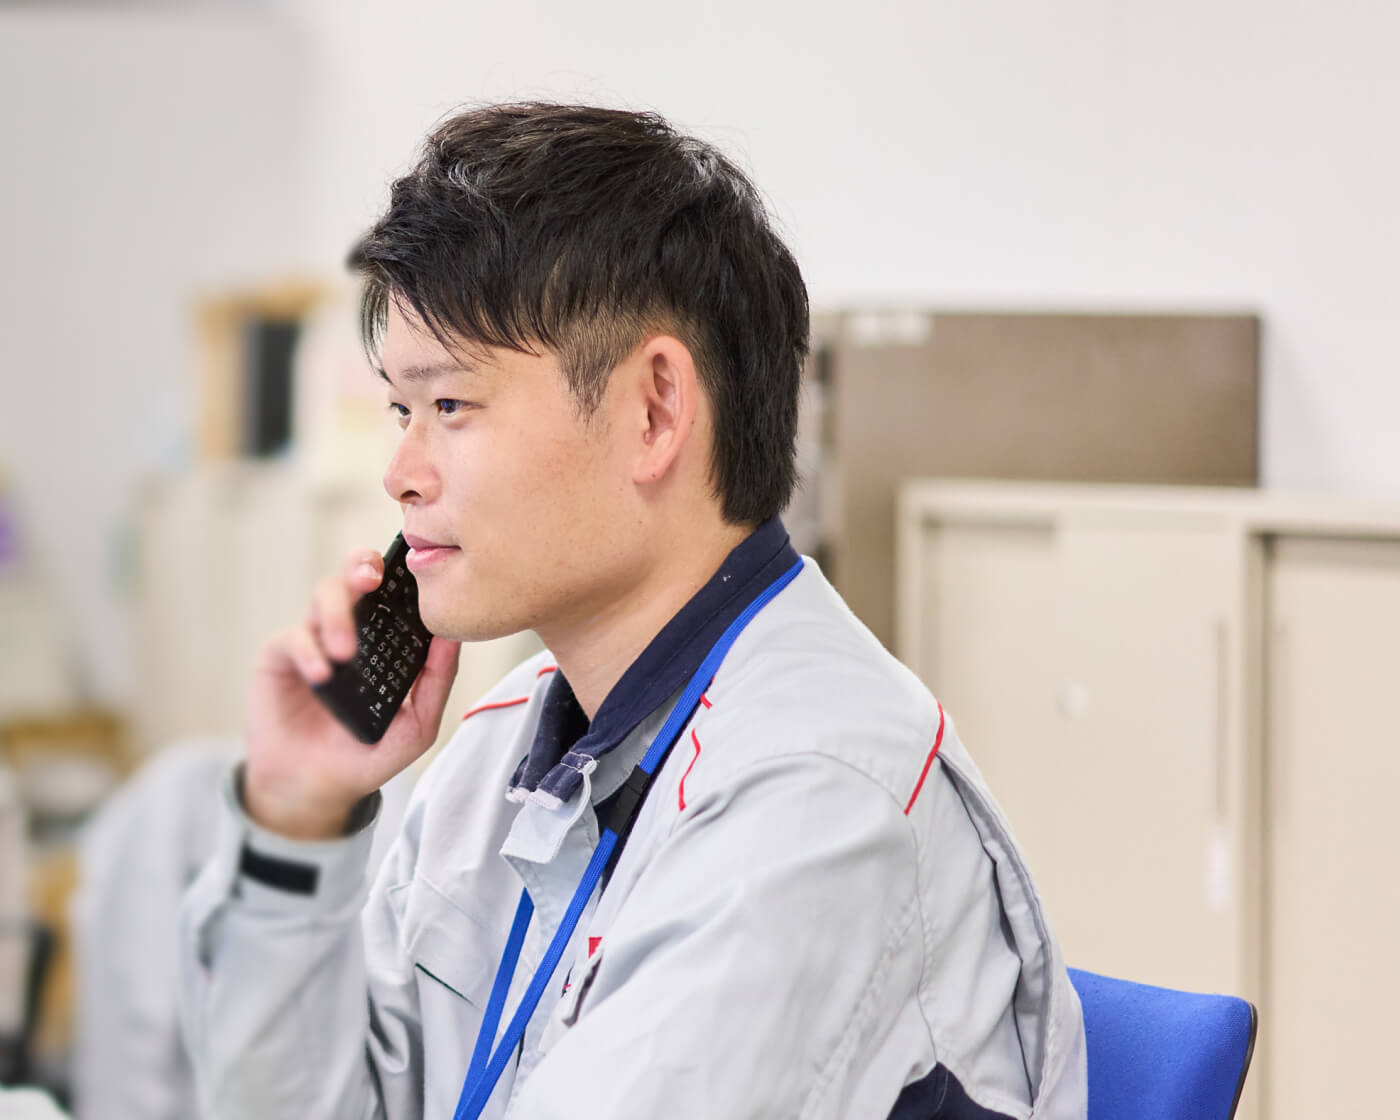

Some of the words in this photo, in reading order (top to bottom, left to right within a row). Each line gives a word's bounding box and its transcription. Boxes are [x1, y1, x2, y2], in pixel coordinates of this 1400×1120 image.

[385, 628, 394, 640] 2
[377, 641, 386, 652] 5
[401, 645, 410, 656] 3
[370, 654, 378, 665] 8
[393, 659, 402, 669] 6
[387, 671, 394, 680] 9
